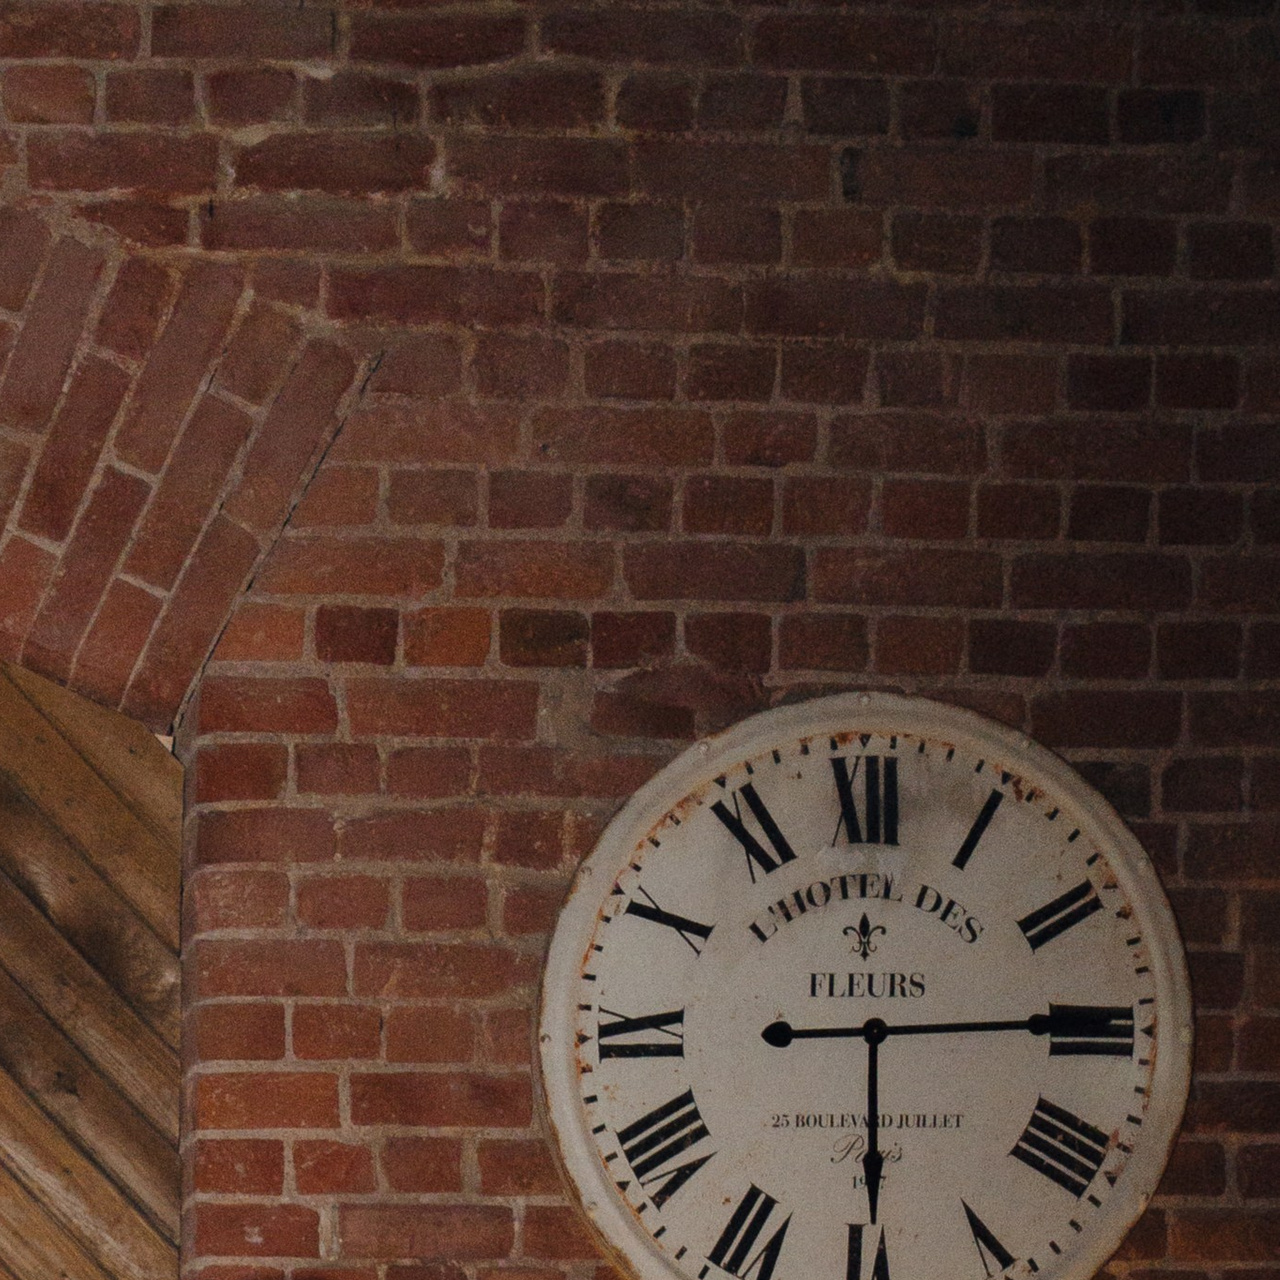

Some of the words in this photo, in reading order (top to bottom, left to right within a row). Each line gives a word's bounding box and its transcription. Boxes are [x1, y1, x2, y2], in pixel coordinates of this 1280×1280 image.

[709, 782, 798, 884] XI
[829, 755, 900, 848] XII
[950, 788, 1005, 871] I
[624, 885, 716, 956] X
[914, 883, 985, 943] DES
[1014, 880, 1105, 955] II
[809, 972, 926, 999] FLEURS
[597, 1005, 685, 1064] IX
[614, 1086, 718, 1211] VIII
[772, 1114, 790, 1128] 25
[795, 1113, 894, 1128] BOULEVAD
[896, 1113, 964, 1129] JUILLET
[1008, 1094, 1114, 1199] IIII
[960, 1197, 1020, 1278] V
